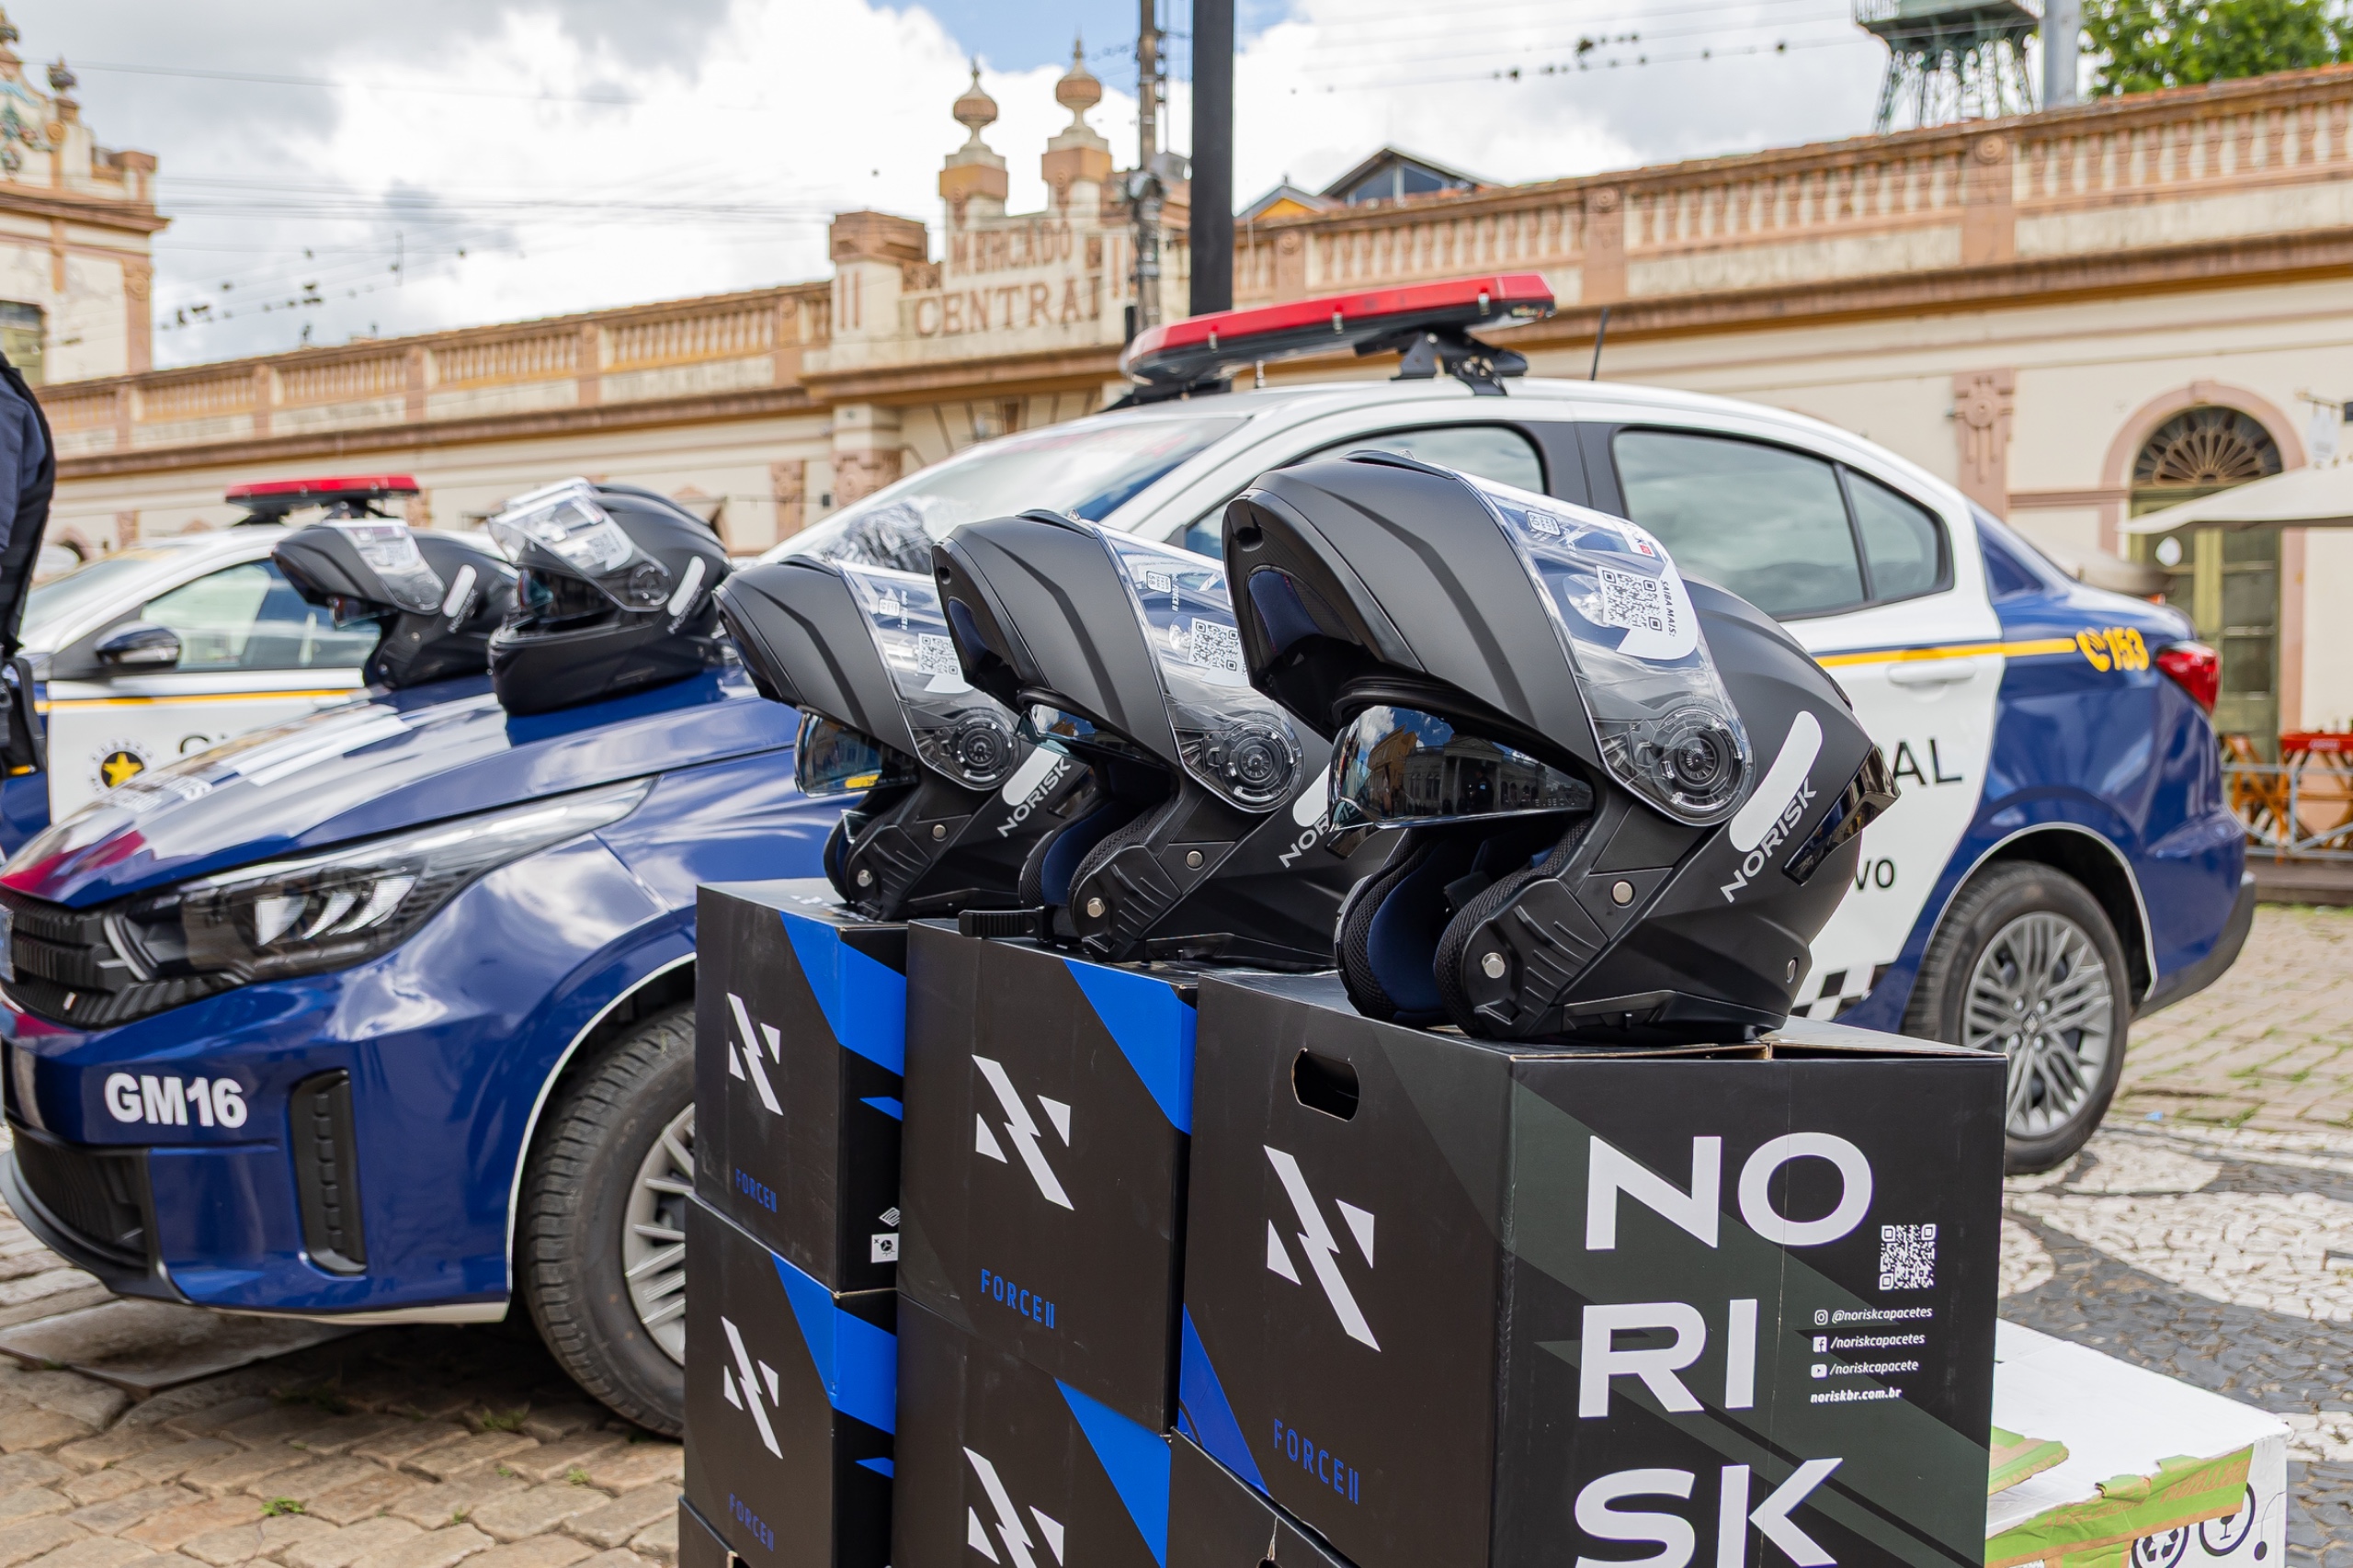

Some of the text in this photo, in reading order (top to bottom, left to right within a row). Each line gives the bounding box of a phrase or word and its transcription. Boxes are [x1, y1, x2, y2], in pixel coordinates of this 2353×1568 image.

[1660, 579, 1677, 637] SAIBA MAIS:
[2103, 627, 2150, 671] 153
[1876, 738, 1963, 787] AL
[996, 756, 1072, 837] NORISK
[1720, 777, 1817, 903] NORISK
[104, 1073, 248, 1129] GM16
[1586, 1131, 1872, 1251] NO
[1831, 1306, 1933, 1324] @noriskcapacetes
[1579, 1299, 1757, 1418] RI
[1810, 1386, 1902, 1403] noriskbr.com.br
[1574, 1458, 1843, 1568] SK
